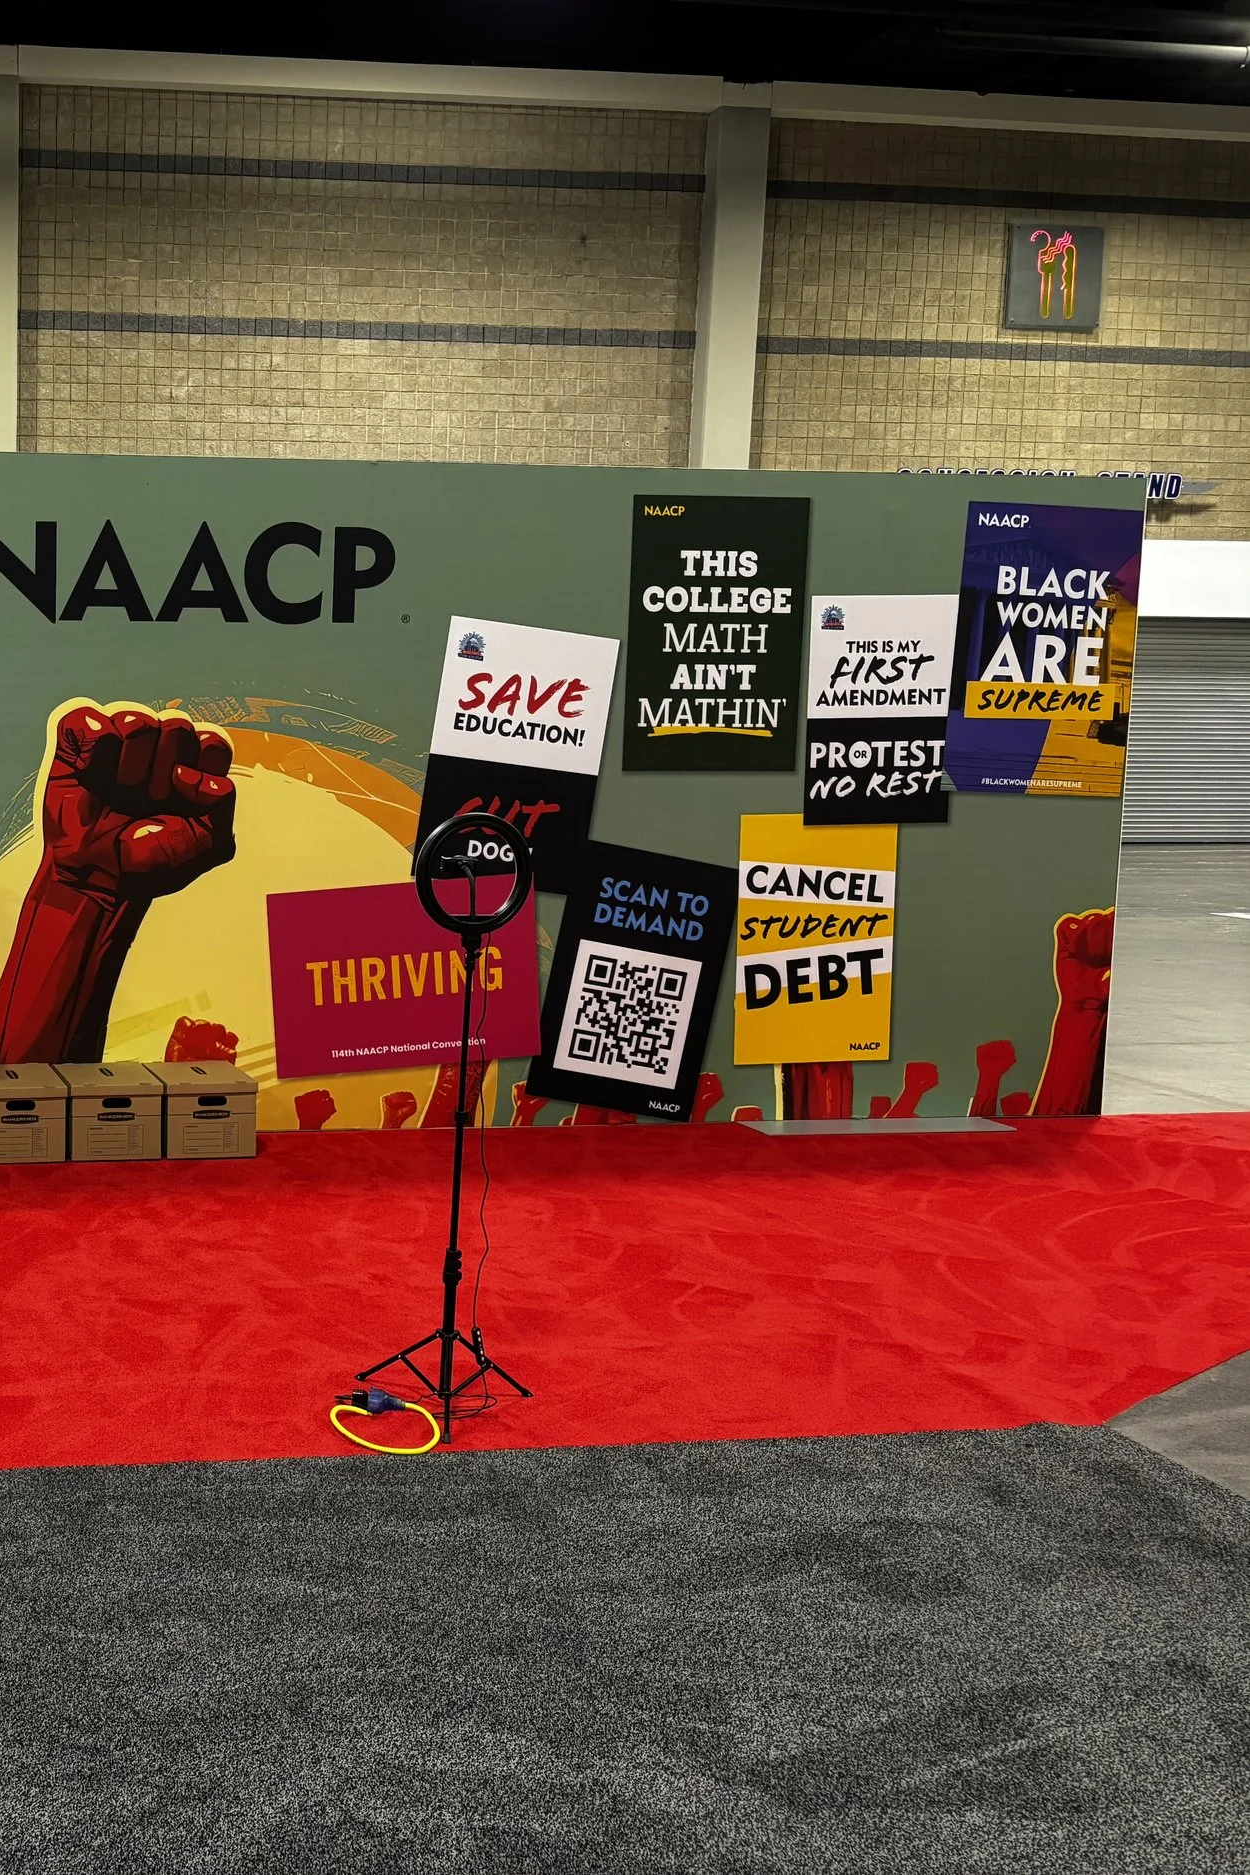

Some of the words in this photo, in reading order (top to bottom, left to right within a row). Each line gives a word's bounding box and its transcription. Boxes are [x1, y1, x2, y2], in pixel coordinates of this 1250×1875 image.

[644, 505, 685, 517] NAACP
[978, 513, 1030, 528] NAACP
[681, 550, 758, 577] THIS
[996, 565, 1111, 600] BLACK
[642, 585, 792, 613] COLLEGE
[997, 601, 1108, 632] WOMEN
[662, 622, 769, 653] MATH
[846, 641, 878, 653] THIS
[882, 640, 893, 653] IS
[898, 640, 921, 653] MY
[830, 654, 934, 689] FIRST
[979, 631, 1104, 686] ARE
[670, 664, 757, 690] AIN'T
[458, 672, 592, 718] SAVE
[816, 688, 946, 707] AMENDMENT
[977, 688, 1104, 713] SUPREME
[637, 698, 787, 728] MATHIN'
[453, 712, 585, 747] EDUCATION!
[810, 740, 946, 769] PROTEST
[854, 750, 867, 759] OR
[810, 775, 856, 800] NO
[866, 769, 943, 798] REST
[981, 777, 1082, 789] #BLACKWOMENARESUPREME
[467, 840, 533, 862] DOG
[600, 876, 669, 910] SCAN
[677, 891, 710, 917] TO
[745, 864, 884, 903] CANCEL
[594, 902, 704, 941] DEMAND
[740, 913, 888, 941] STUDENT
[306, 946, 503, 1006] THRIVING
[744, 948, 884, 1011] DEBT
[331, 1048, 354, 1058] 114th
[356, 1046, 388, 1056] NAACP
[390, 1041, 430, 1053] National
[432, 1037, 486, 1049] Convetion
[849, 1042, 881, 1051] NAACP
[649, 1100, 680, 1113] NAACP
